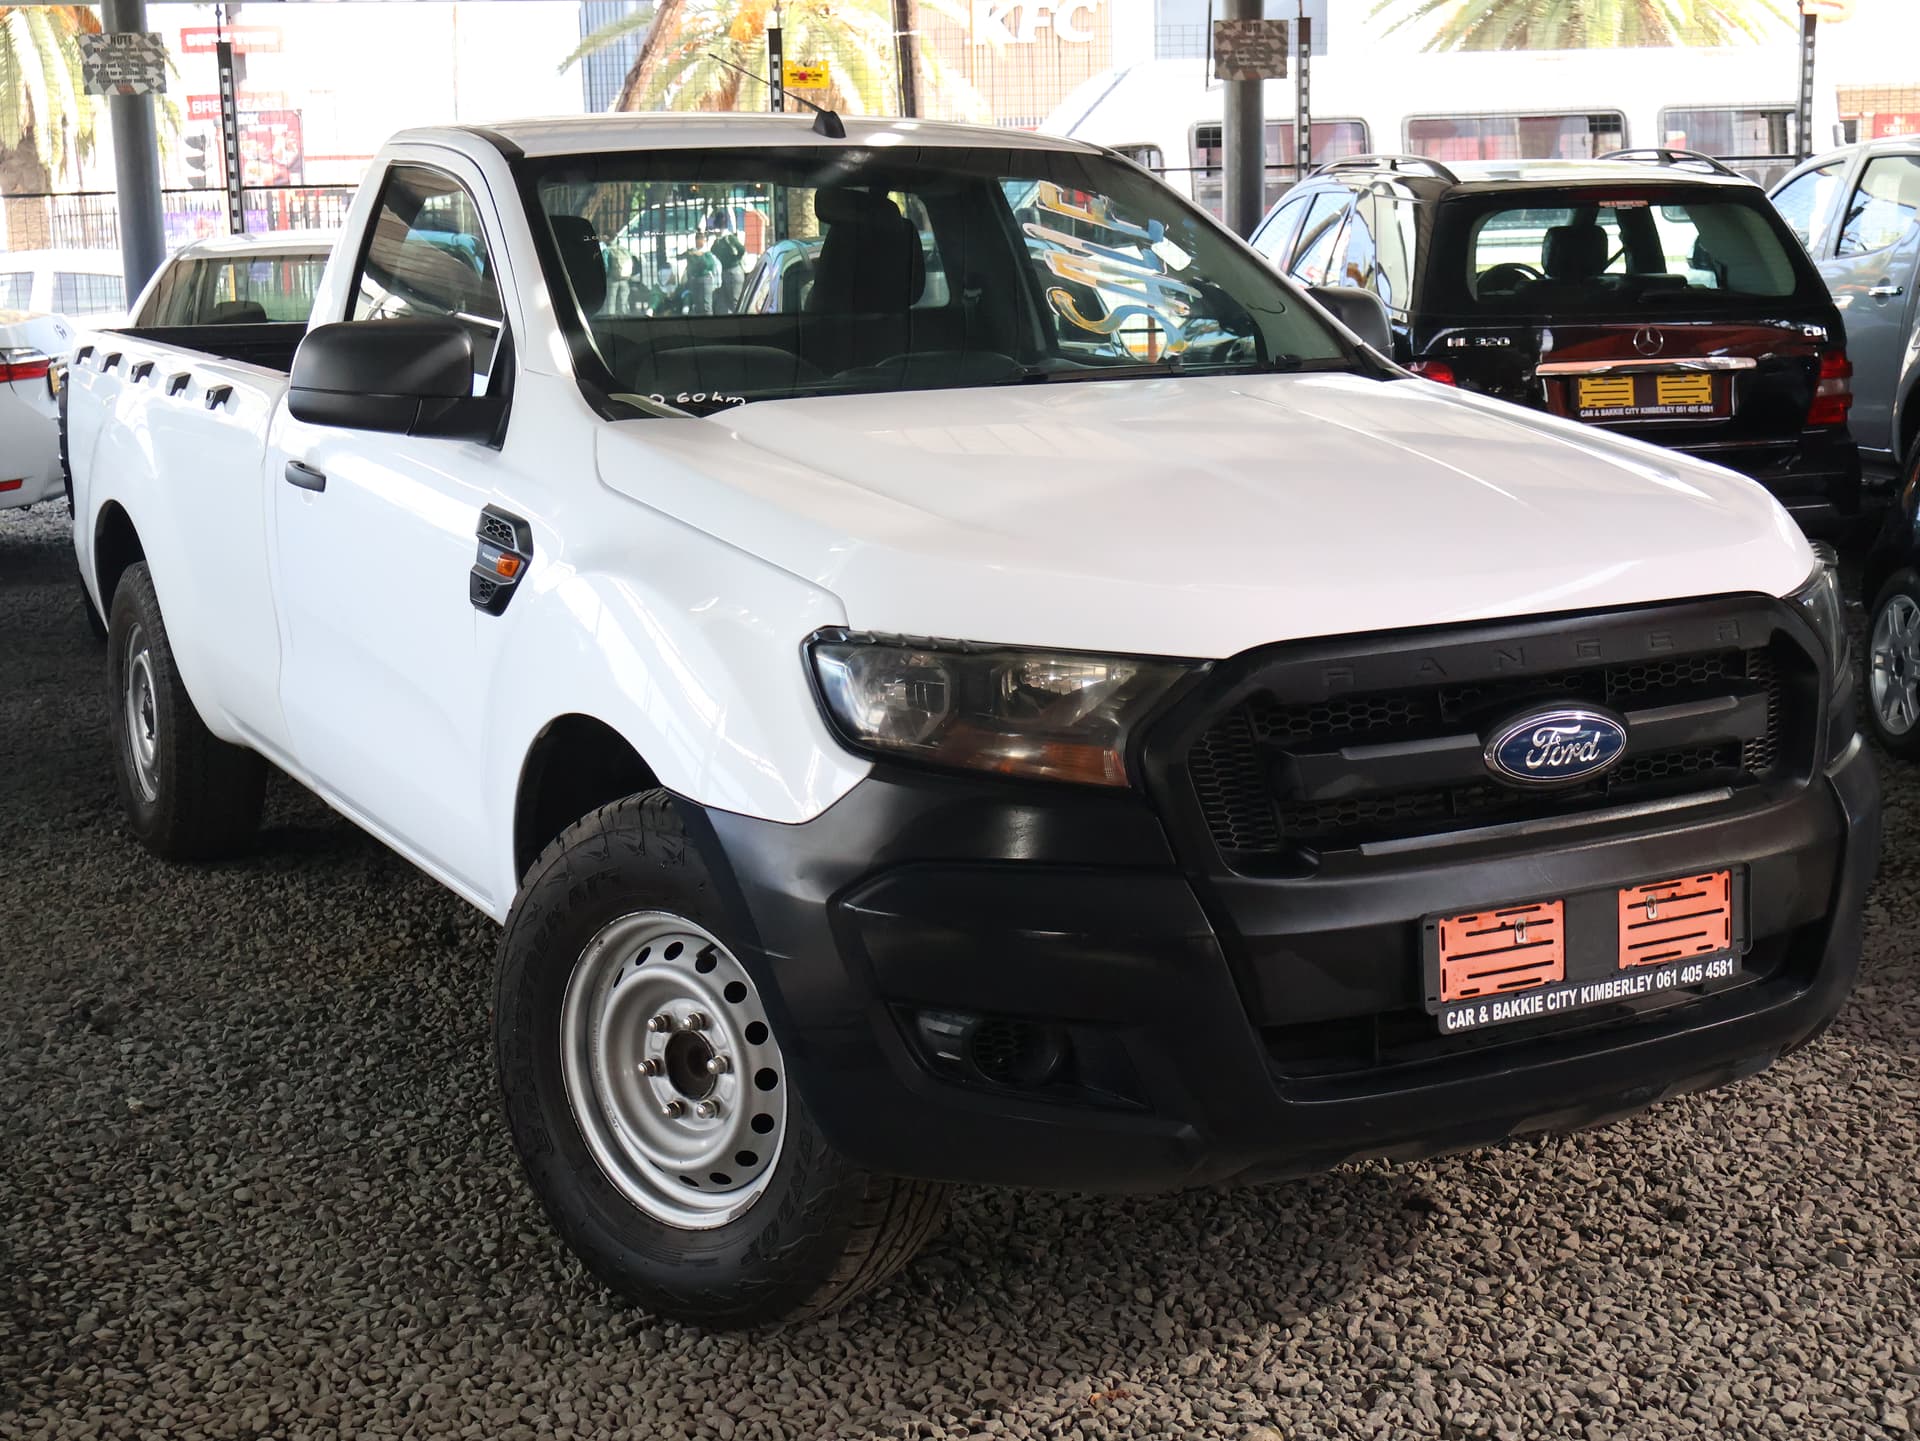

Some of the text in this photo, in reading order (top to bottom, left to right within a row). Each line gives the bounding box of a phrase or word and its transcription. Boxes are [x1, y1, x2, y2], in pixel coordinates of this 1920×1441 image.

[110, 34, 132, 45] NOTE
[973, 0, 1097, 45] KFC
[1803, 327, 1827, 338] CDI
[1580, 409, 1594, 417] CAR
[1600, 408, 1624, 416] BAKKIE
[1625, 407, 1640, 415] CITY
[1640, 405, 1675, 414] KIMBERLEY
[1322, 617, 1741, 690] RANGER
[1525, 724, 1601, 769] Ford
[1446, 958, 1734, 1030] CAR & BAKKIE CITY KIMBERLEY 061 405 4581
